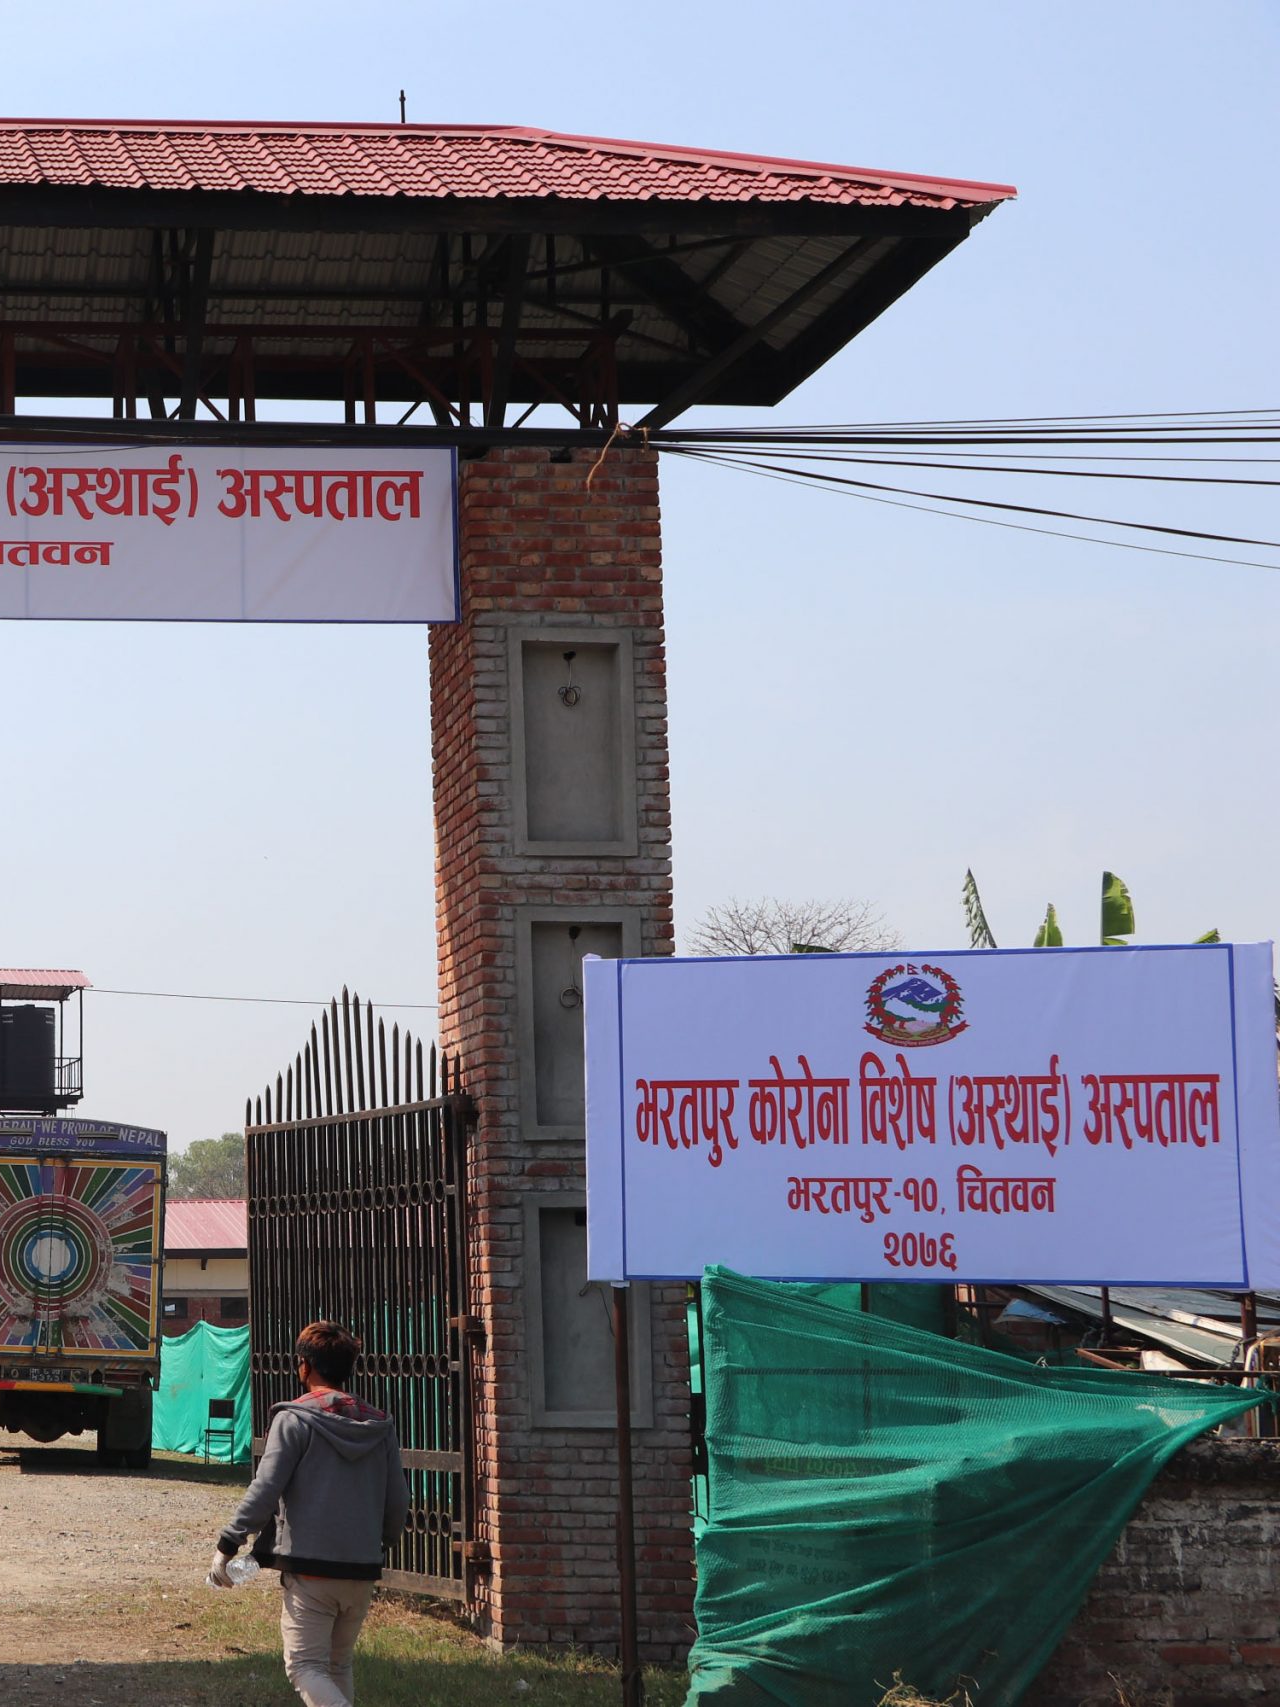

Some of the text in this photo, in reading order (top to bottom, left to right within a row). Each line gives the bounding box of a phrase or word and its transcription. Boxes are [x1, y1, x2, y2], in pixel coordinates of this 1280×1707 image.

[6, 454, 199, 525] (अस्थाई)
[217, 468, 423, 521] अस्पताल
[636, 1051, 1220, 1168] भरतपुर कोरोना विशेष (अस्थाई) अस्पताल
[10, 1136, 95, 1147] GOD BLESS YOU
[119, 1127, 161, 1148] NEPAL
[957, 1165, 1055, 1213] चितवन
[883, 1232, 958, 1271] २०७६
